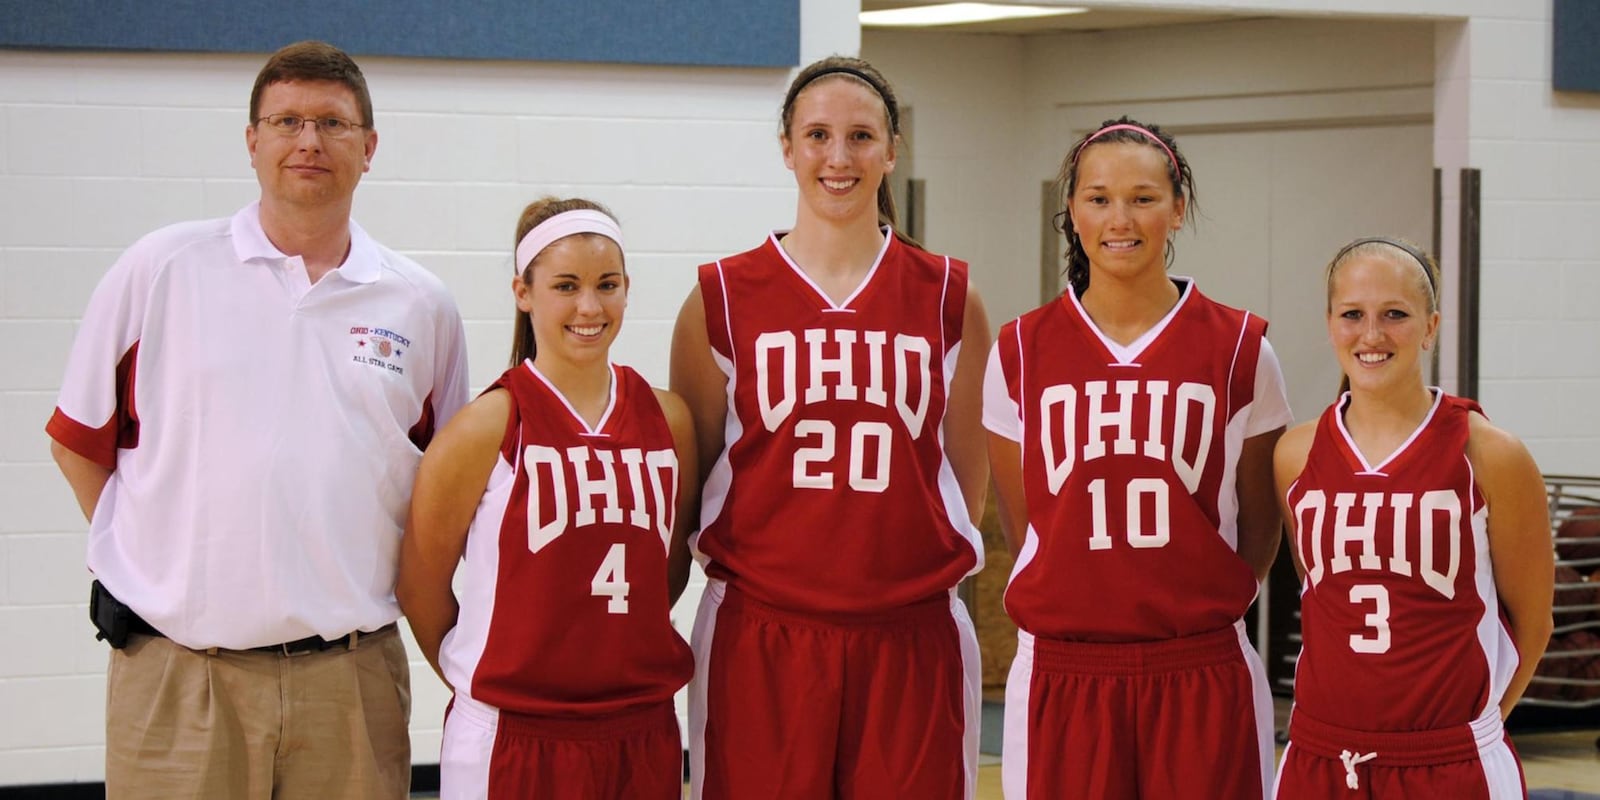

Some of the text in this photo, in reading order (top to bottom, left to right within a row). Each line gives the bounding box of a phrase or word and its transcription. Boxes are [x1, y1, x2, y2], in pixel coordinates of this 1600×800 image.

[353, 355, 368, 363] ALL
[369, 358, 386, 368] STAR
[374, 328, 411, 347] KENTUCKY
[755, 328, 931, 441] OHIO
[792, 419, 893, 493] 20
[1040, 379, 1217, 496] OHIO
[523, 444, 679, 558] OHIO
[1087, 478, 1170, 550] 10
[590, 543, 630, 614] 4
[1294, 489, 1462, 600] OHIO
[1349, 584, 1391, 654] 3
